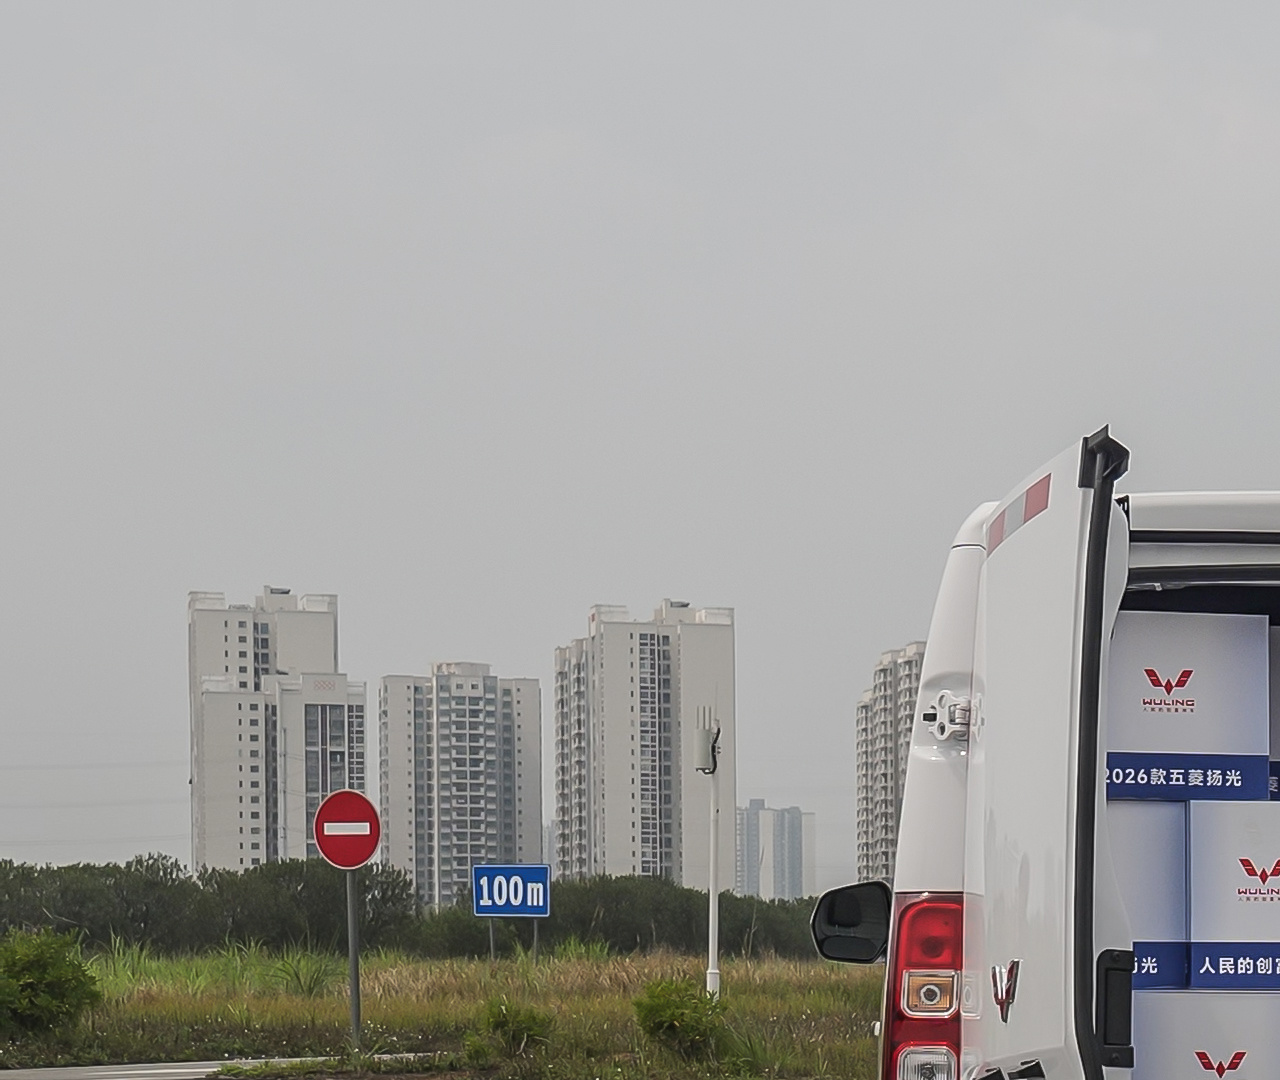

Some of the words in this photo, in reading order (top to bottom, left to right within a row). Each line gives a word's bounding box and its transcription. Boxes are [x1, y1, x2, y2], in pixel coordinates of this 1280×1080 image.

[1142, 698, 1195, 707] WULING
[1105, 768, 1242, 787] 2026款五菱扬光
[479, 875, 544, 906] 100m
